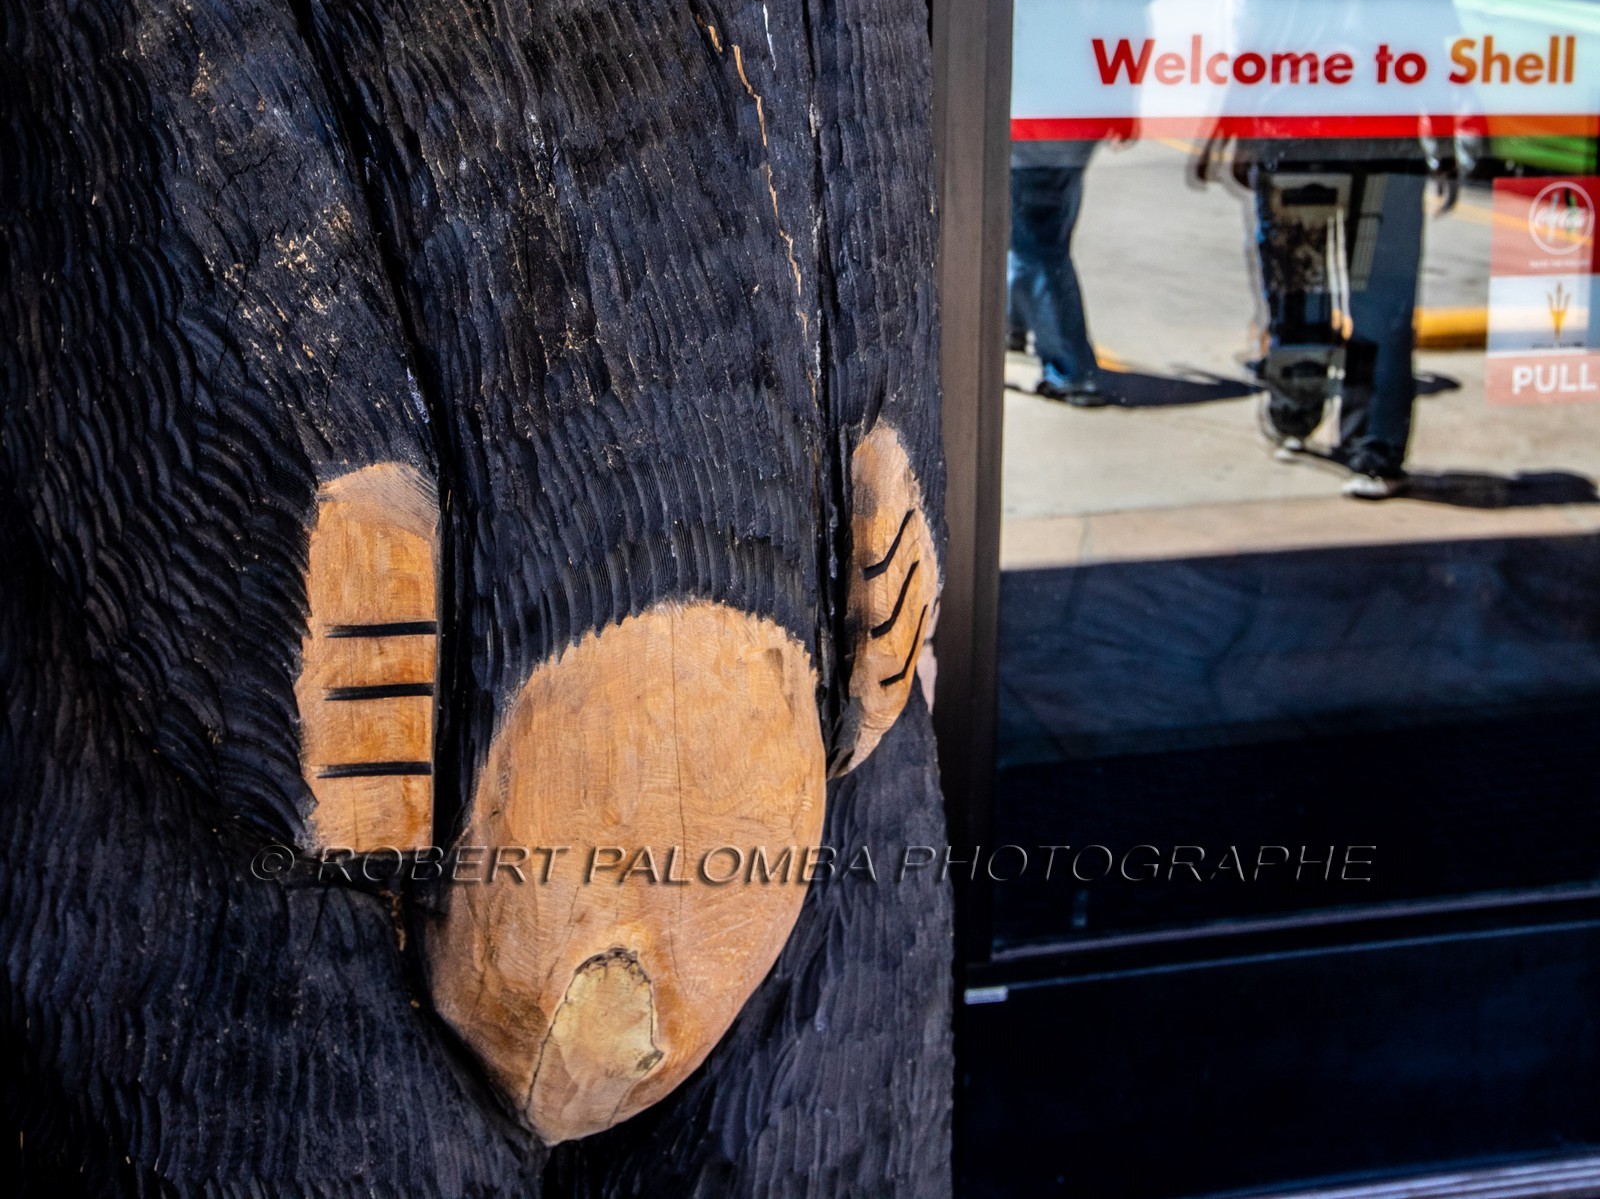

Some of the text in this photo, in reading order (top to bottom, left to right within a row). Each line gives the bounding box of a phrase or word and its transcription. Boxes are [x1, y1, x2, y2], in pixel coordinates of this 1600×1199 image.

[1091, 34, 1577, 86] Welcome to Shell
[1511, 362, 1598, 396] PULL
